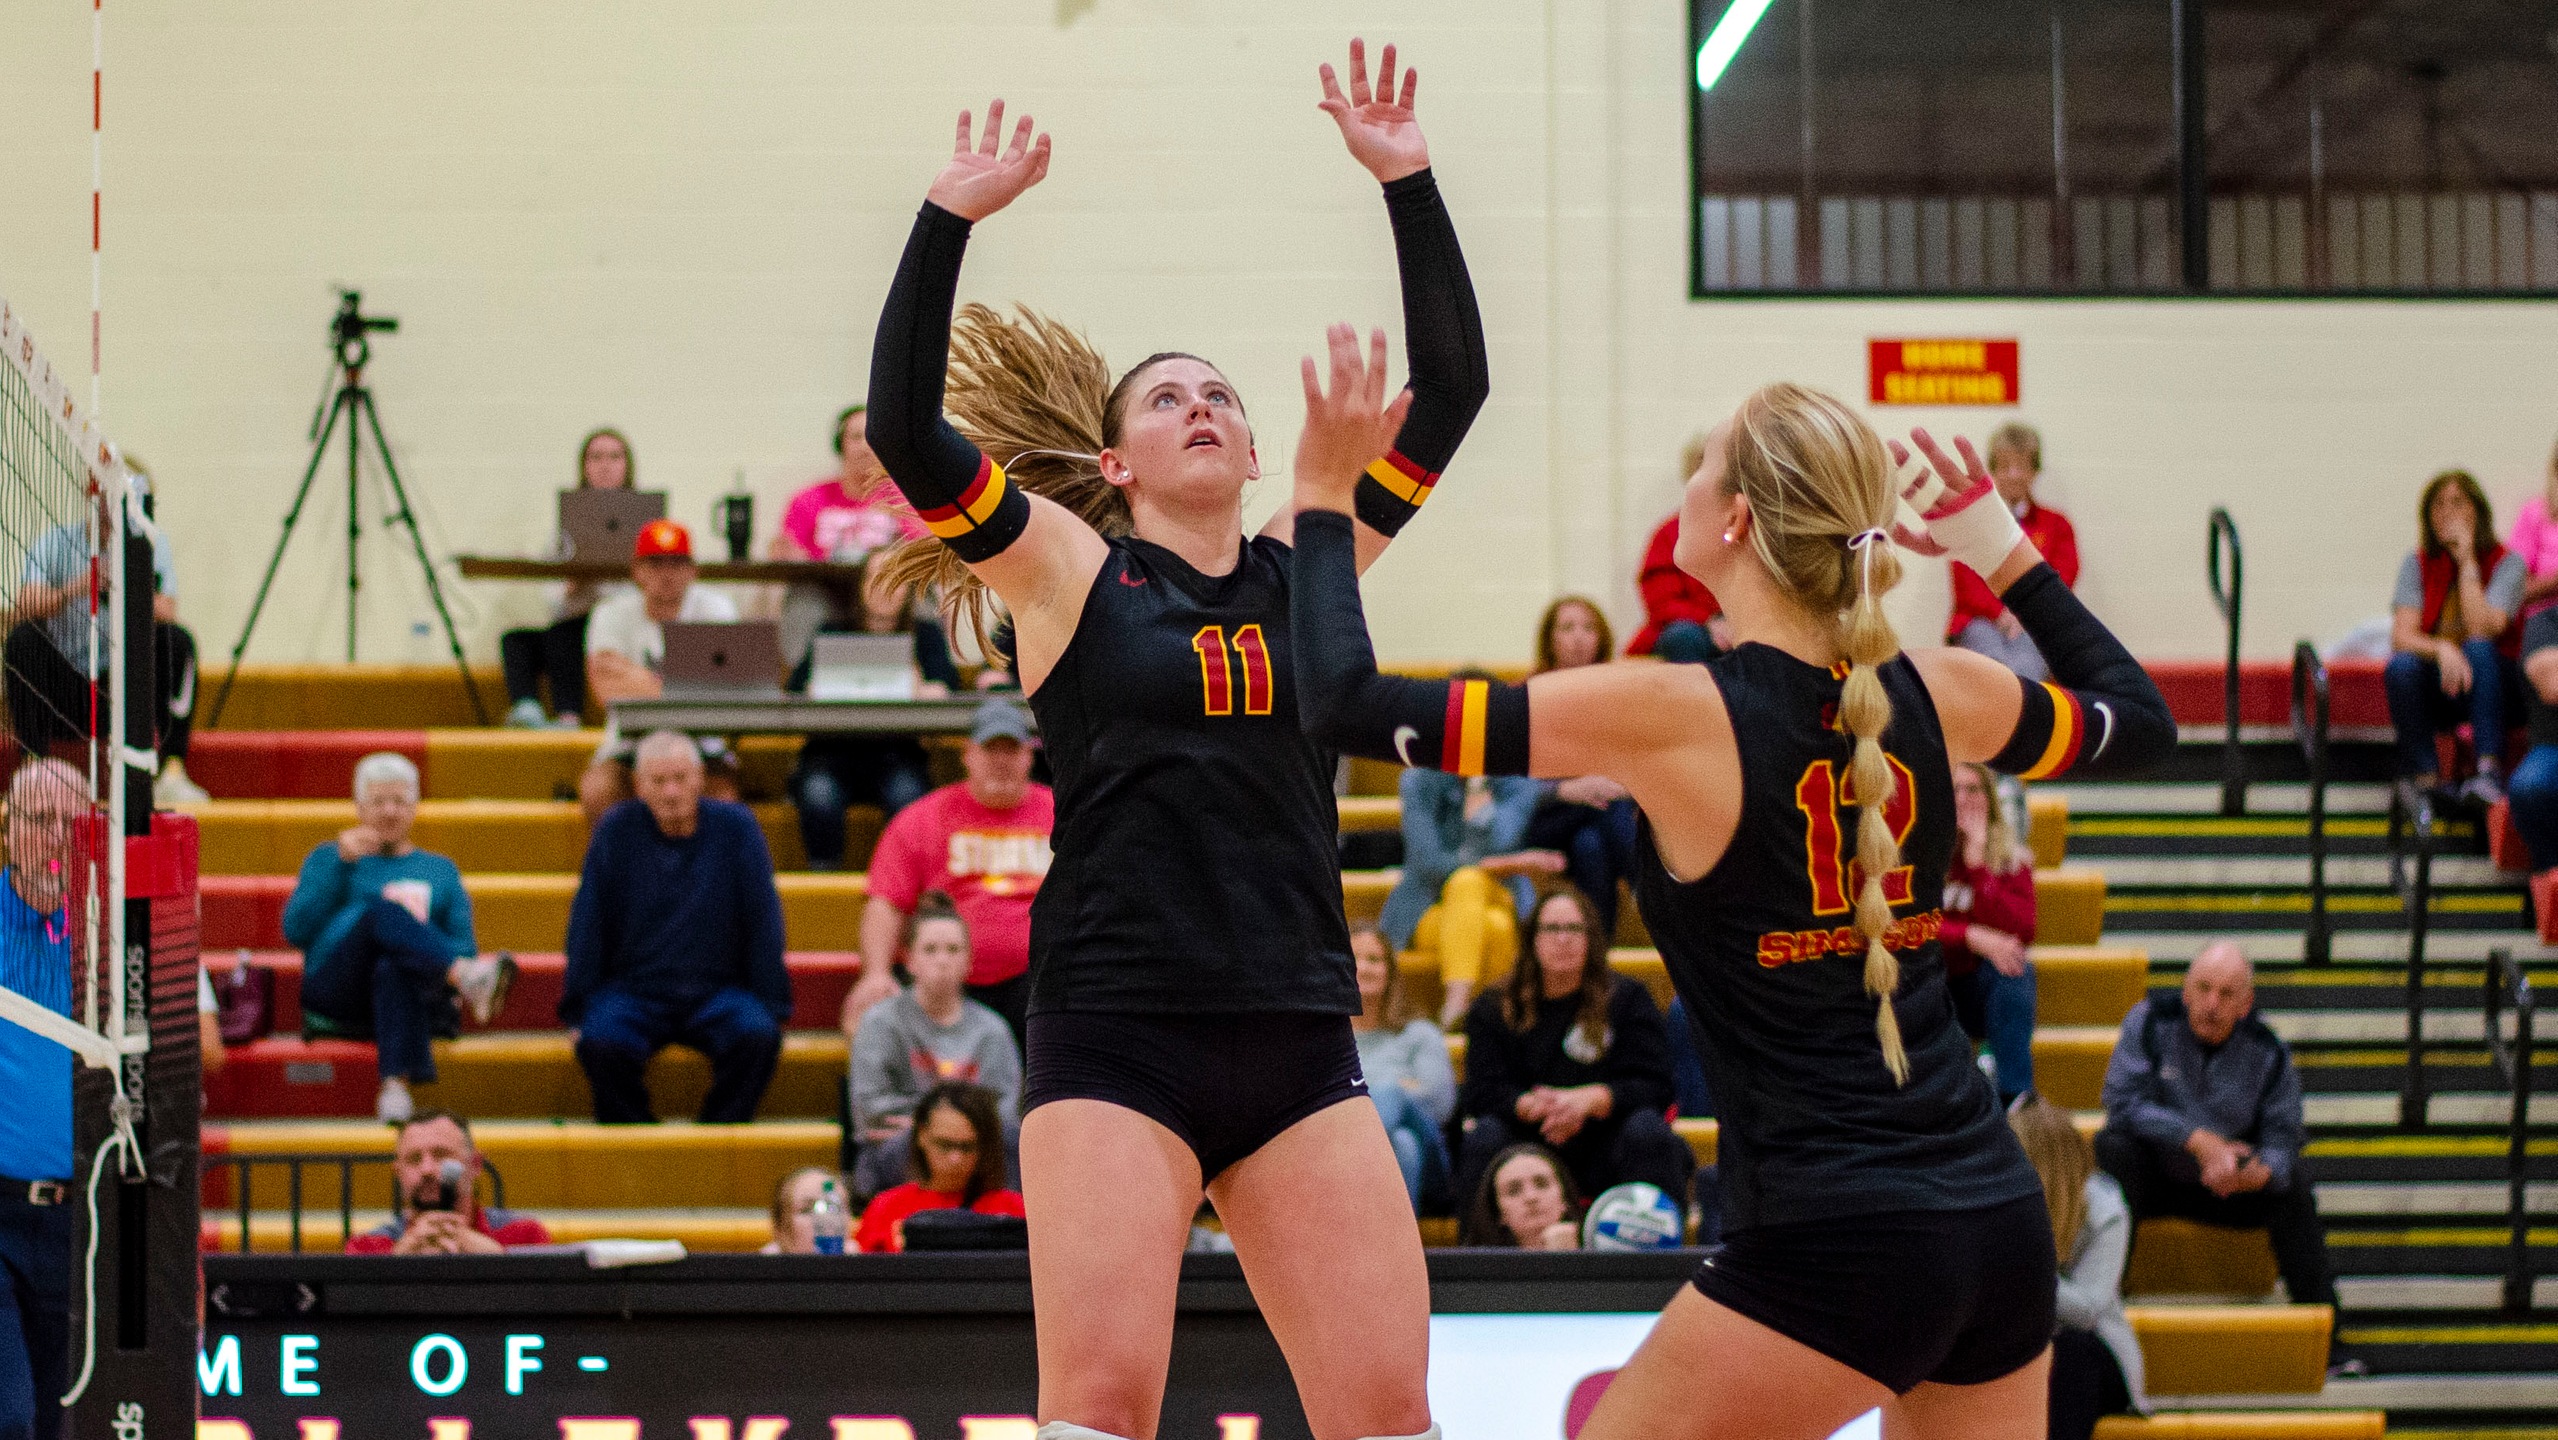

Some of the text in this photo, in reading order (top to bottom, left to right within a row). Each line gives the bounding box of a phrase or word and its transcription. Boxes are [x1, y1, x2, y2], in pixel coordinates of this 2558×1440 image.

[1192, 624, 1273, 715] 11
[1796, 752, 1915, 916] 12
[1757, 908, 1944, 968] SIMSON
